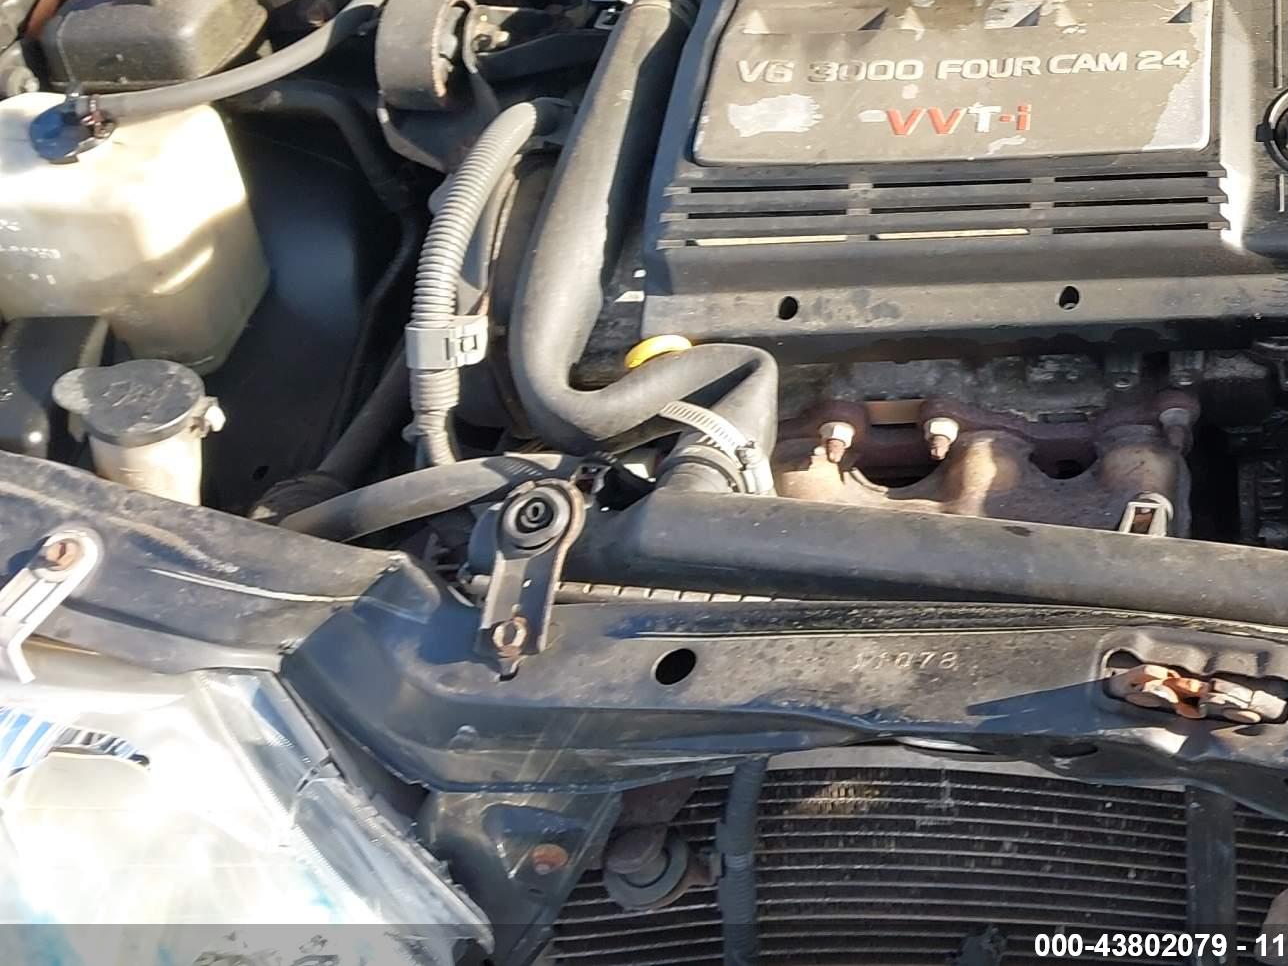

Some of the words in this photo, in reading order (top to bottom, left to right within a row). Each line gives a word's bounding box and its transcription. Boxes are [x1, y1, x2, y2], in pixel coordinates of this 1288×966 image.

[737, 60, 795, 83] V6
[808, 59, 924, 82] 3000
[937, 56, 1041, 80] FOUR
[1048, 52, 1128, 75] CAM
[1136, 49, 1190, 71] 24
[886, 103, 1032, 136] VVT-i
